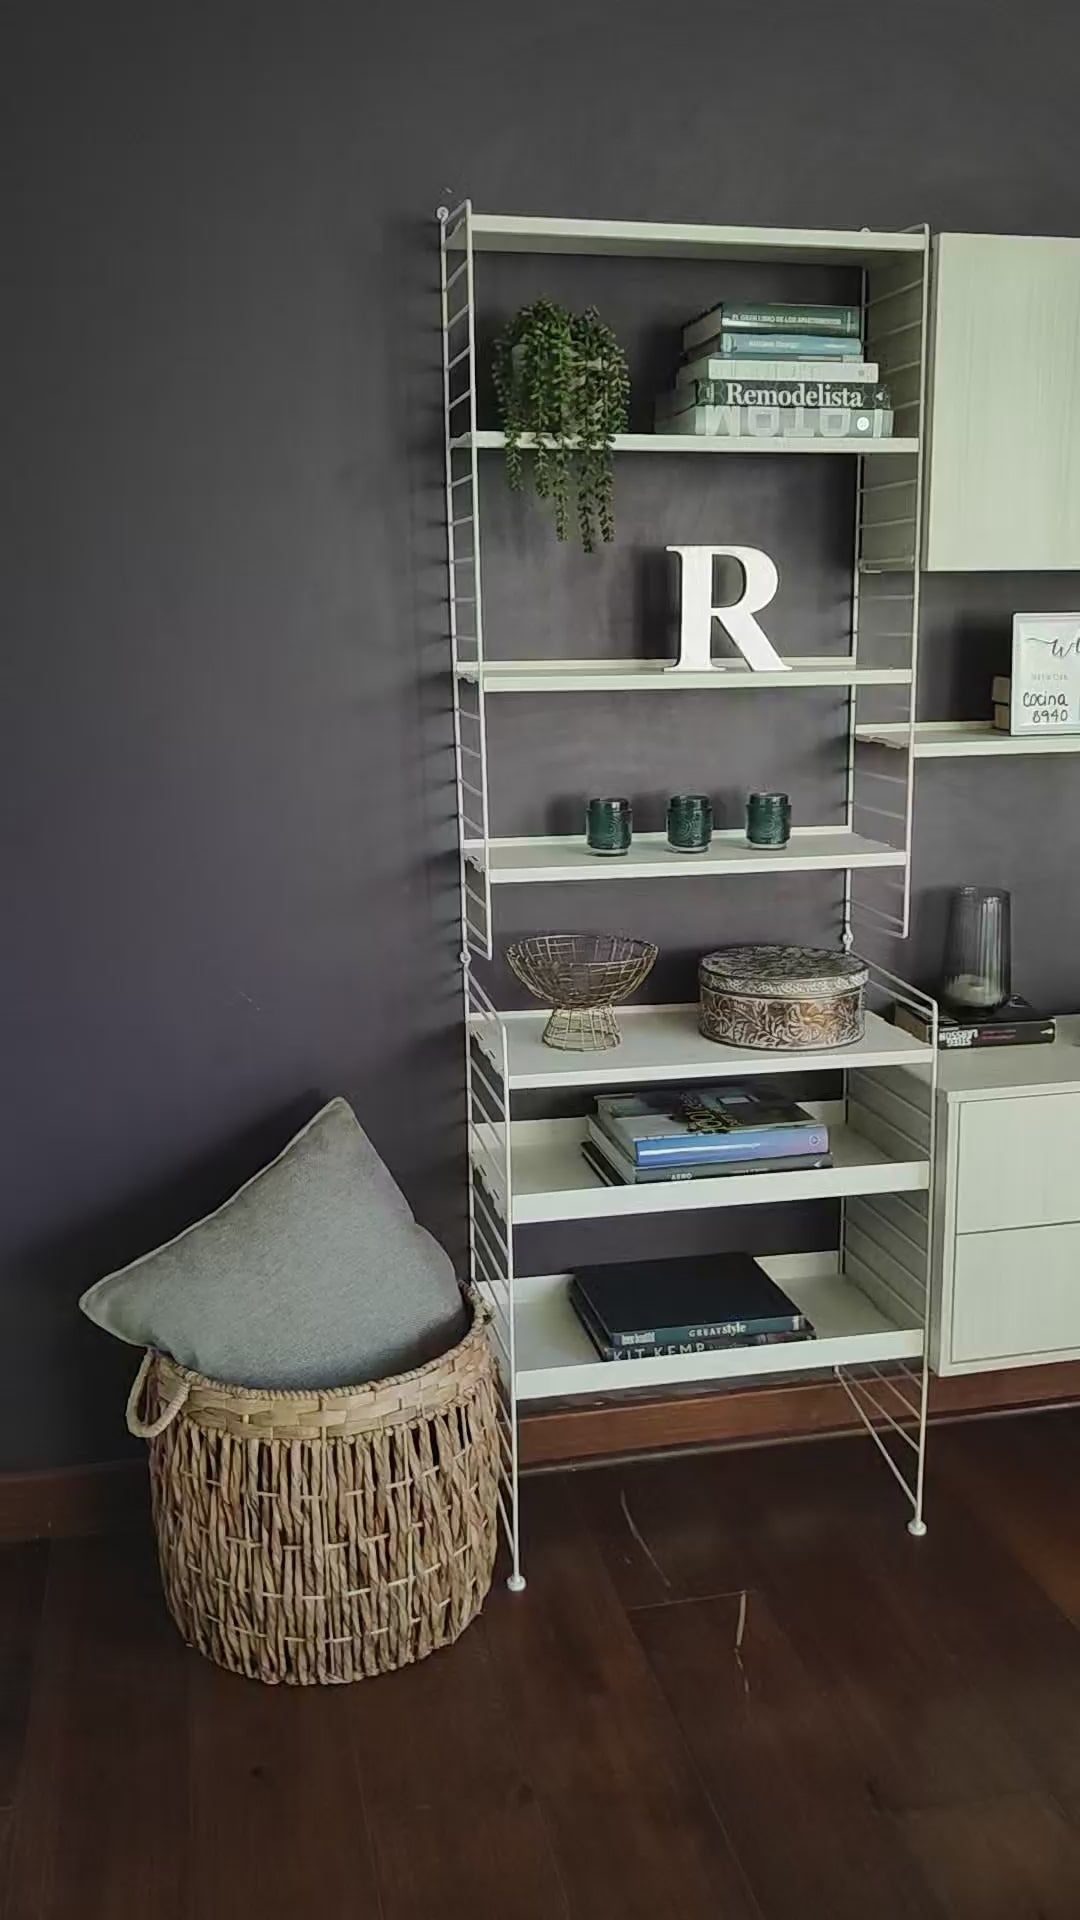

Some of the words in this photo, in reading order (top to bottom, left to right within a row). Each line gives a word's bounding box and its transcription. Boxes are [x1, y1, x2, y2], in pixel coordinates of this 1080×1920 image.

[727, 382, 863, 407] Remodelista
[664, 545, 792, 672] R
[1032, 709, 1068, 723] 8940
[613, 1348, 646, 1360] KIT
